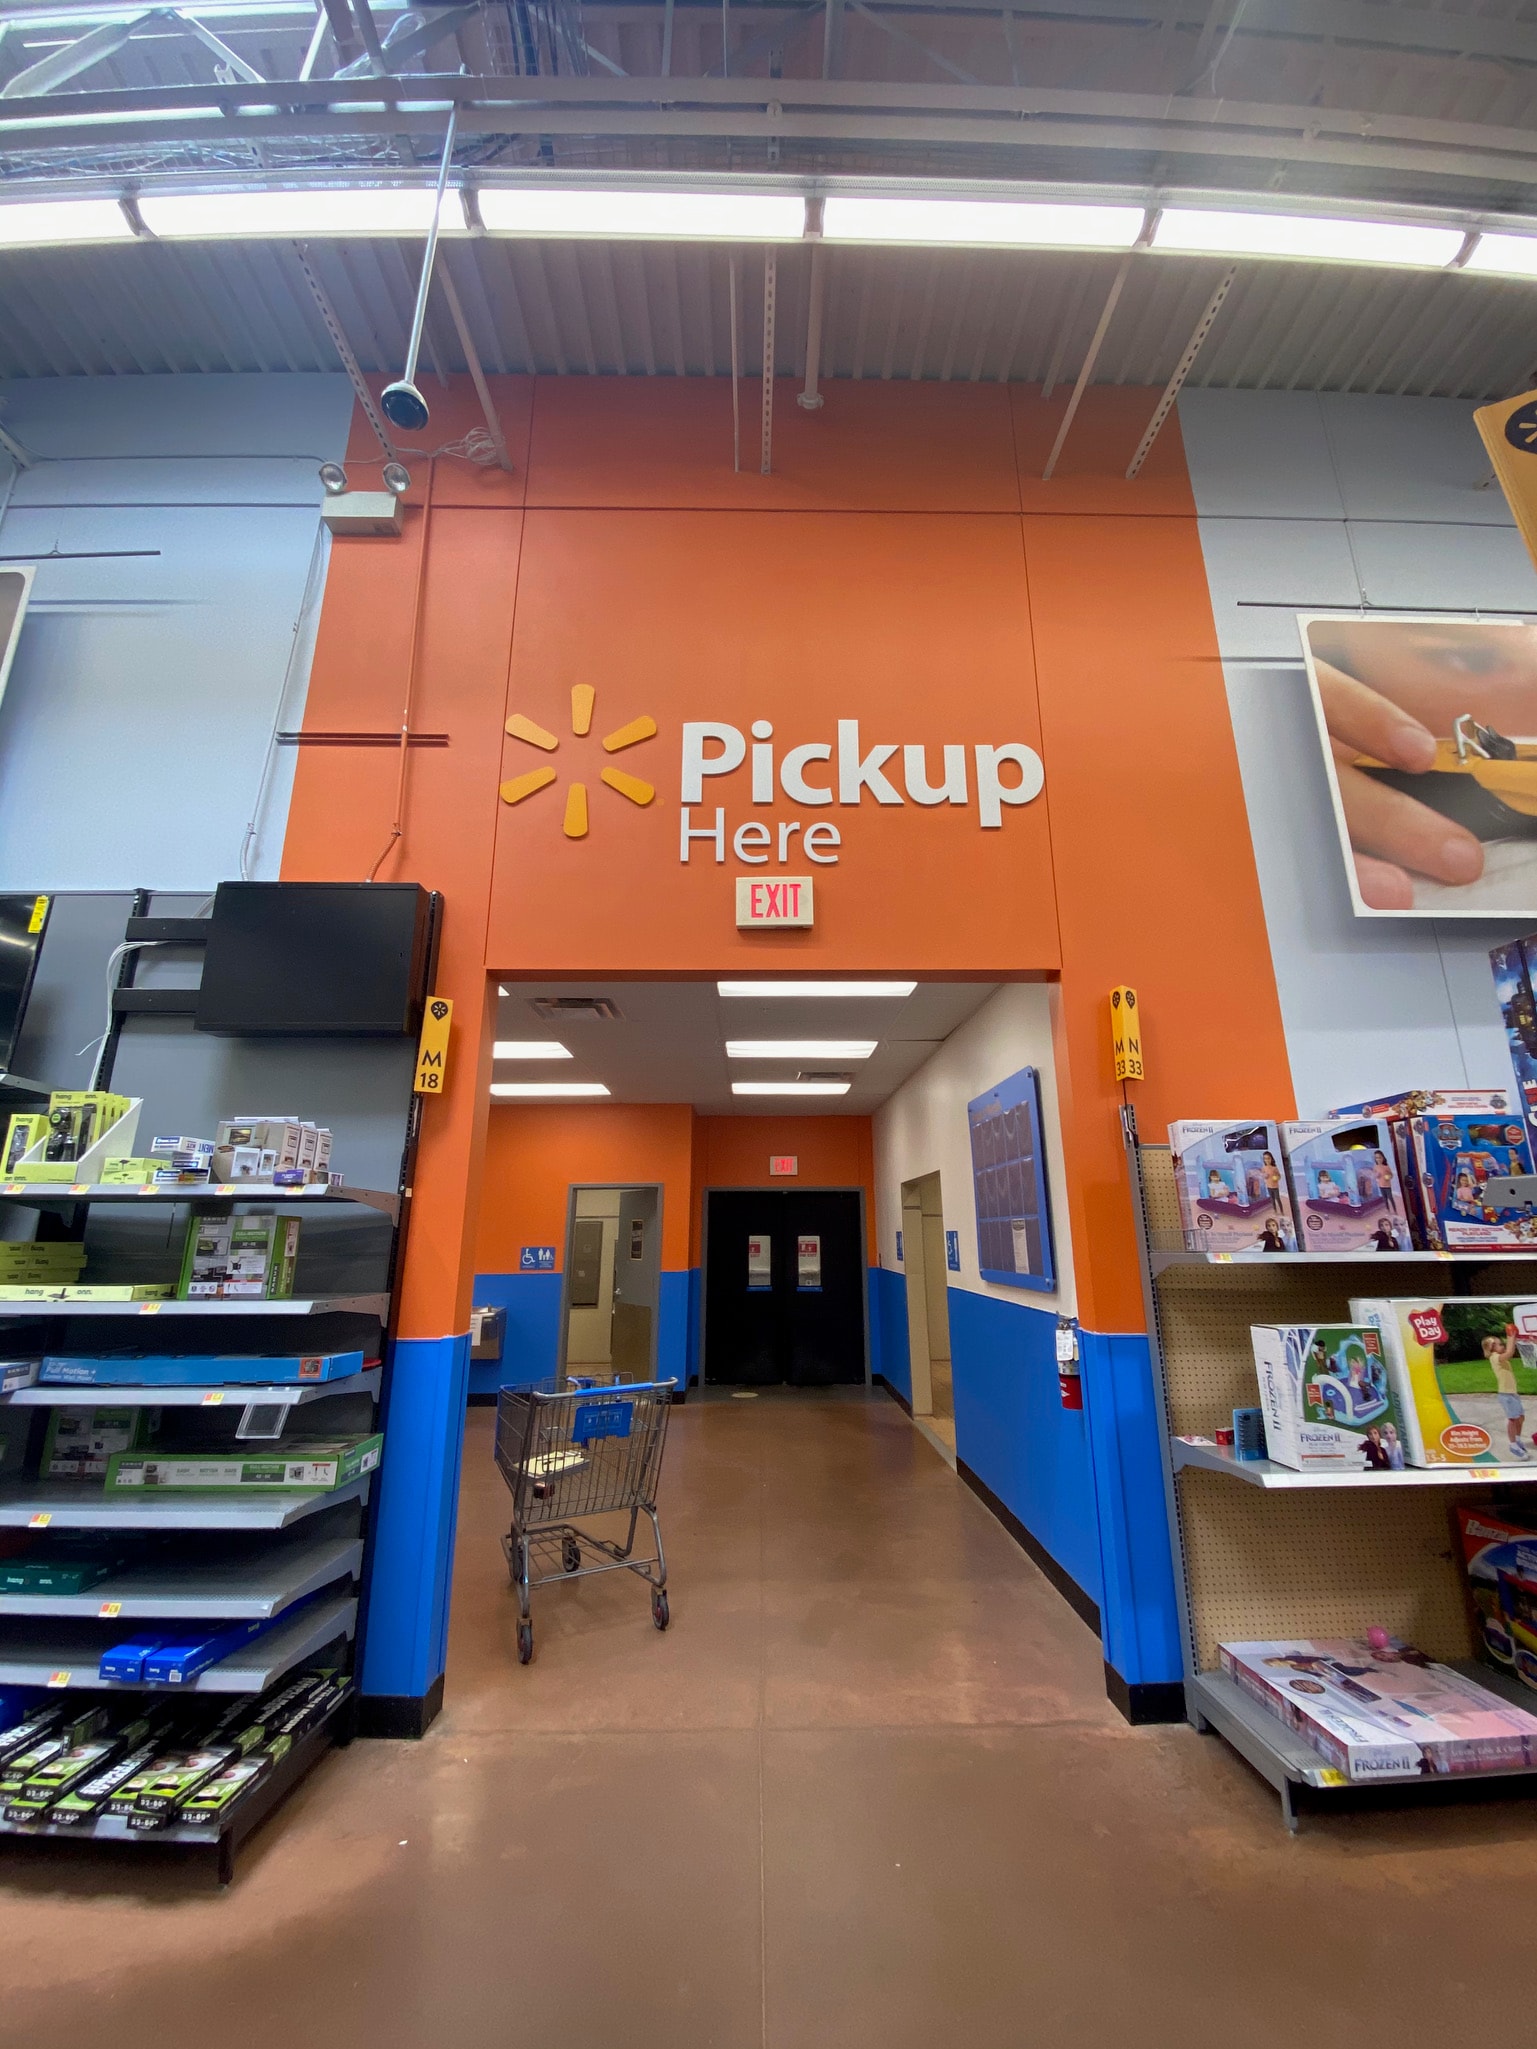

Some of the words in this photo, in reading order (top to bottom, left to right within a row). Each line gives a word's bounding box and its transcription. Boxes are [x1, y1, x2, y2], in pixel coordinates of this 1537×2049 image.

[681, 719, 1045, 828] Pickup
[680, 806, 841, 864] Here
[750, 883, 802, 919] EXIT
[1114, 1036, 1125, 1056] M
[1128, 1036, 1140, 1055] N
[421, 1048, 442, 1068] M
[1128, 1058, 1143, 1076] 33
[1116, 1059, 1127, 1077] 33
[420, 1072, 439, 1089] 18
[773, 1157, 795, 1174] EXIT
[1413, 1315, 1437, 1328] Play
[1420, 1326, 1442, 1339] Day
[1263, 1361, 1279, 1418] FROZEN
[1301, 1432, 1334, 1443] FROZEN
[1354, 1758, 1401, 1772] FROZEN
